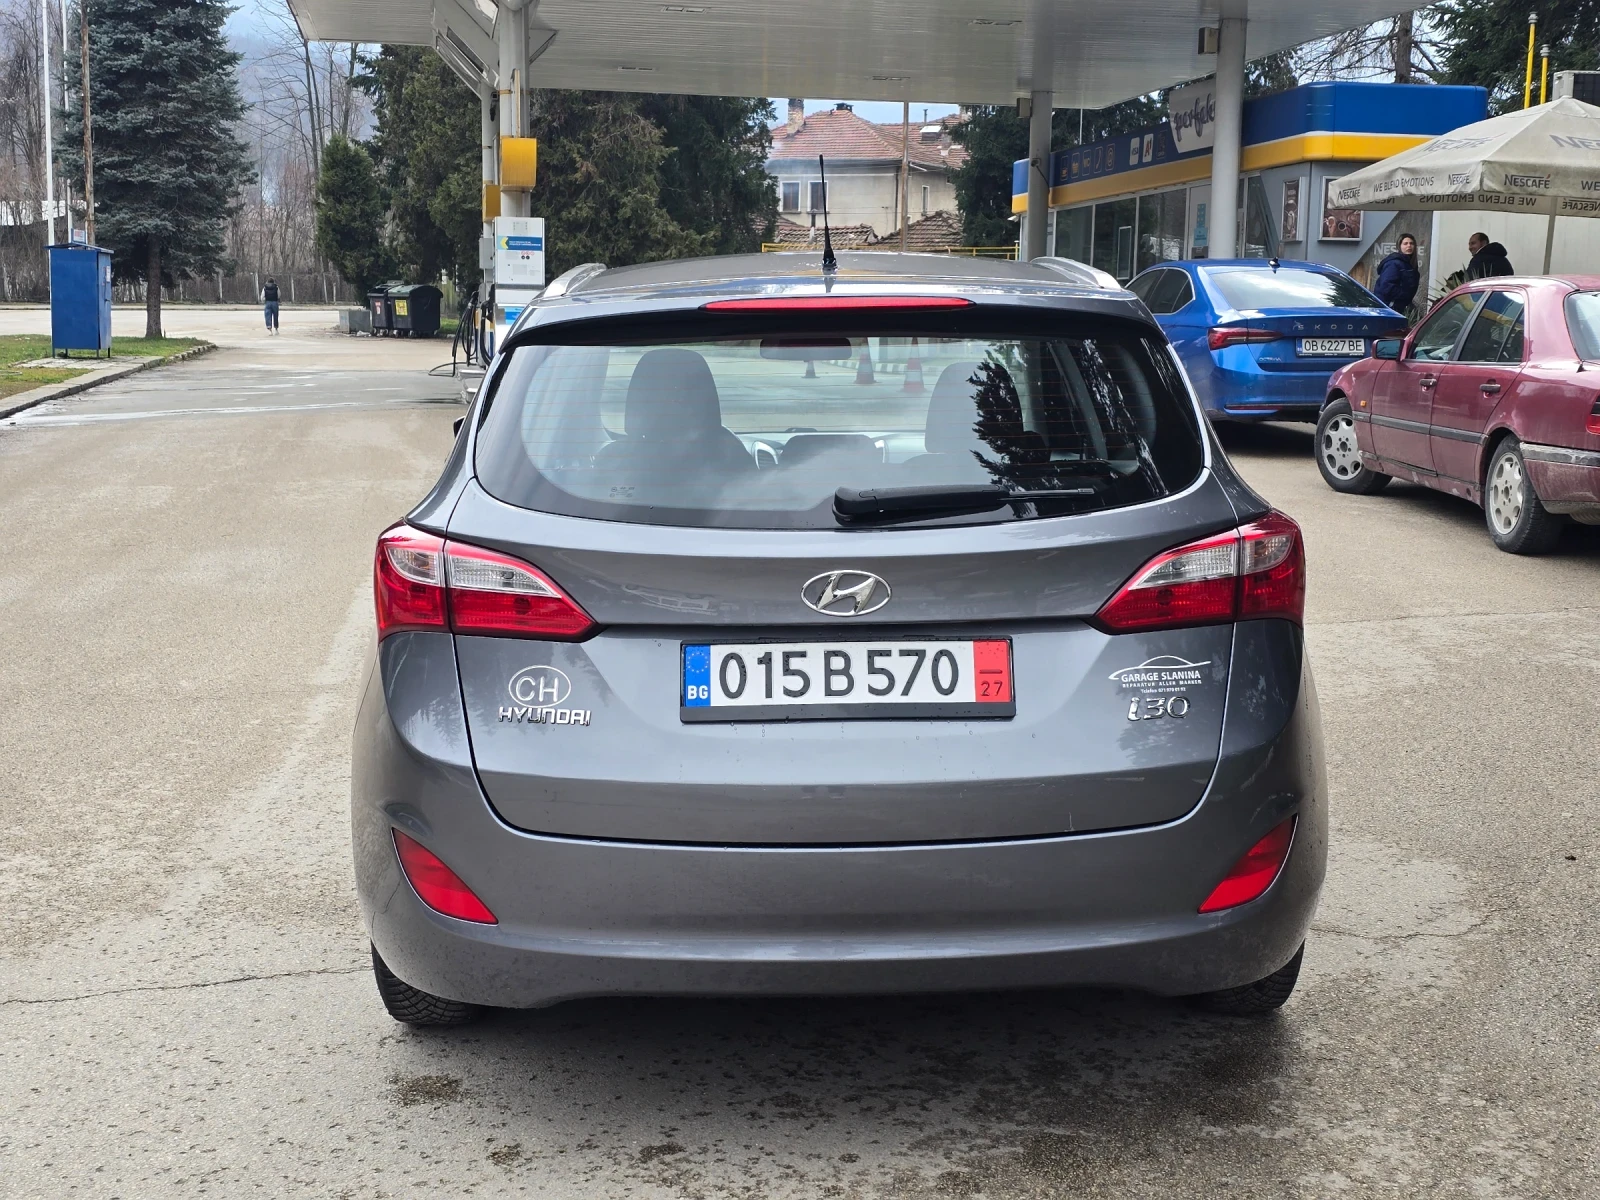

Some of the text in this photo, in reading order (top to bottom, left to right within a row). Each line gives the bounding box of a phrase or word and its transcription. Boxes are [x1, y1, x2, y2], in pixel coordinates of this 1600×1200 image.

[1174, 93, 1216, 142] perfek
[1373, 183, 1383, 193] WE
[1401, 177, 1434, 188] EMOTIONS
[1504, 174, 1551, 189] NESCAFÉ
[1304, 340, 1318, 351] OB
[1320, 340, 1346, 351] 6227
[1348, 340, 1362, 351] BE
[1121, 670, 1201, 682] GARAGE SLANINA
[516, 676, 559, 702] CH
[687, 685, 708, 700] BG
[980, 680, 1003, 697] 27
[499, 706, 591, 726] HYUNDAI
[1128, 696, 1190, 721] i30
